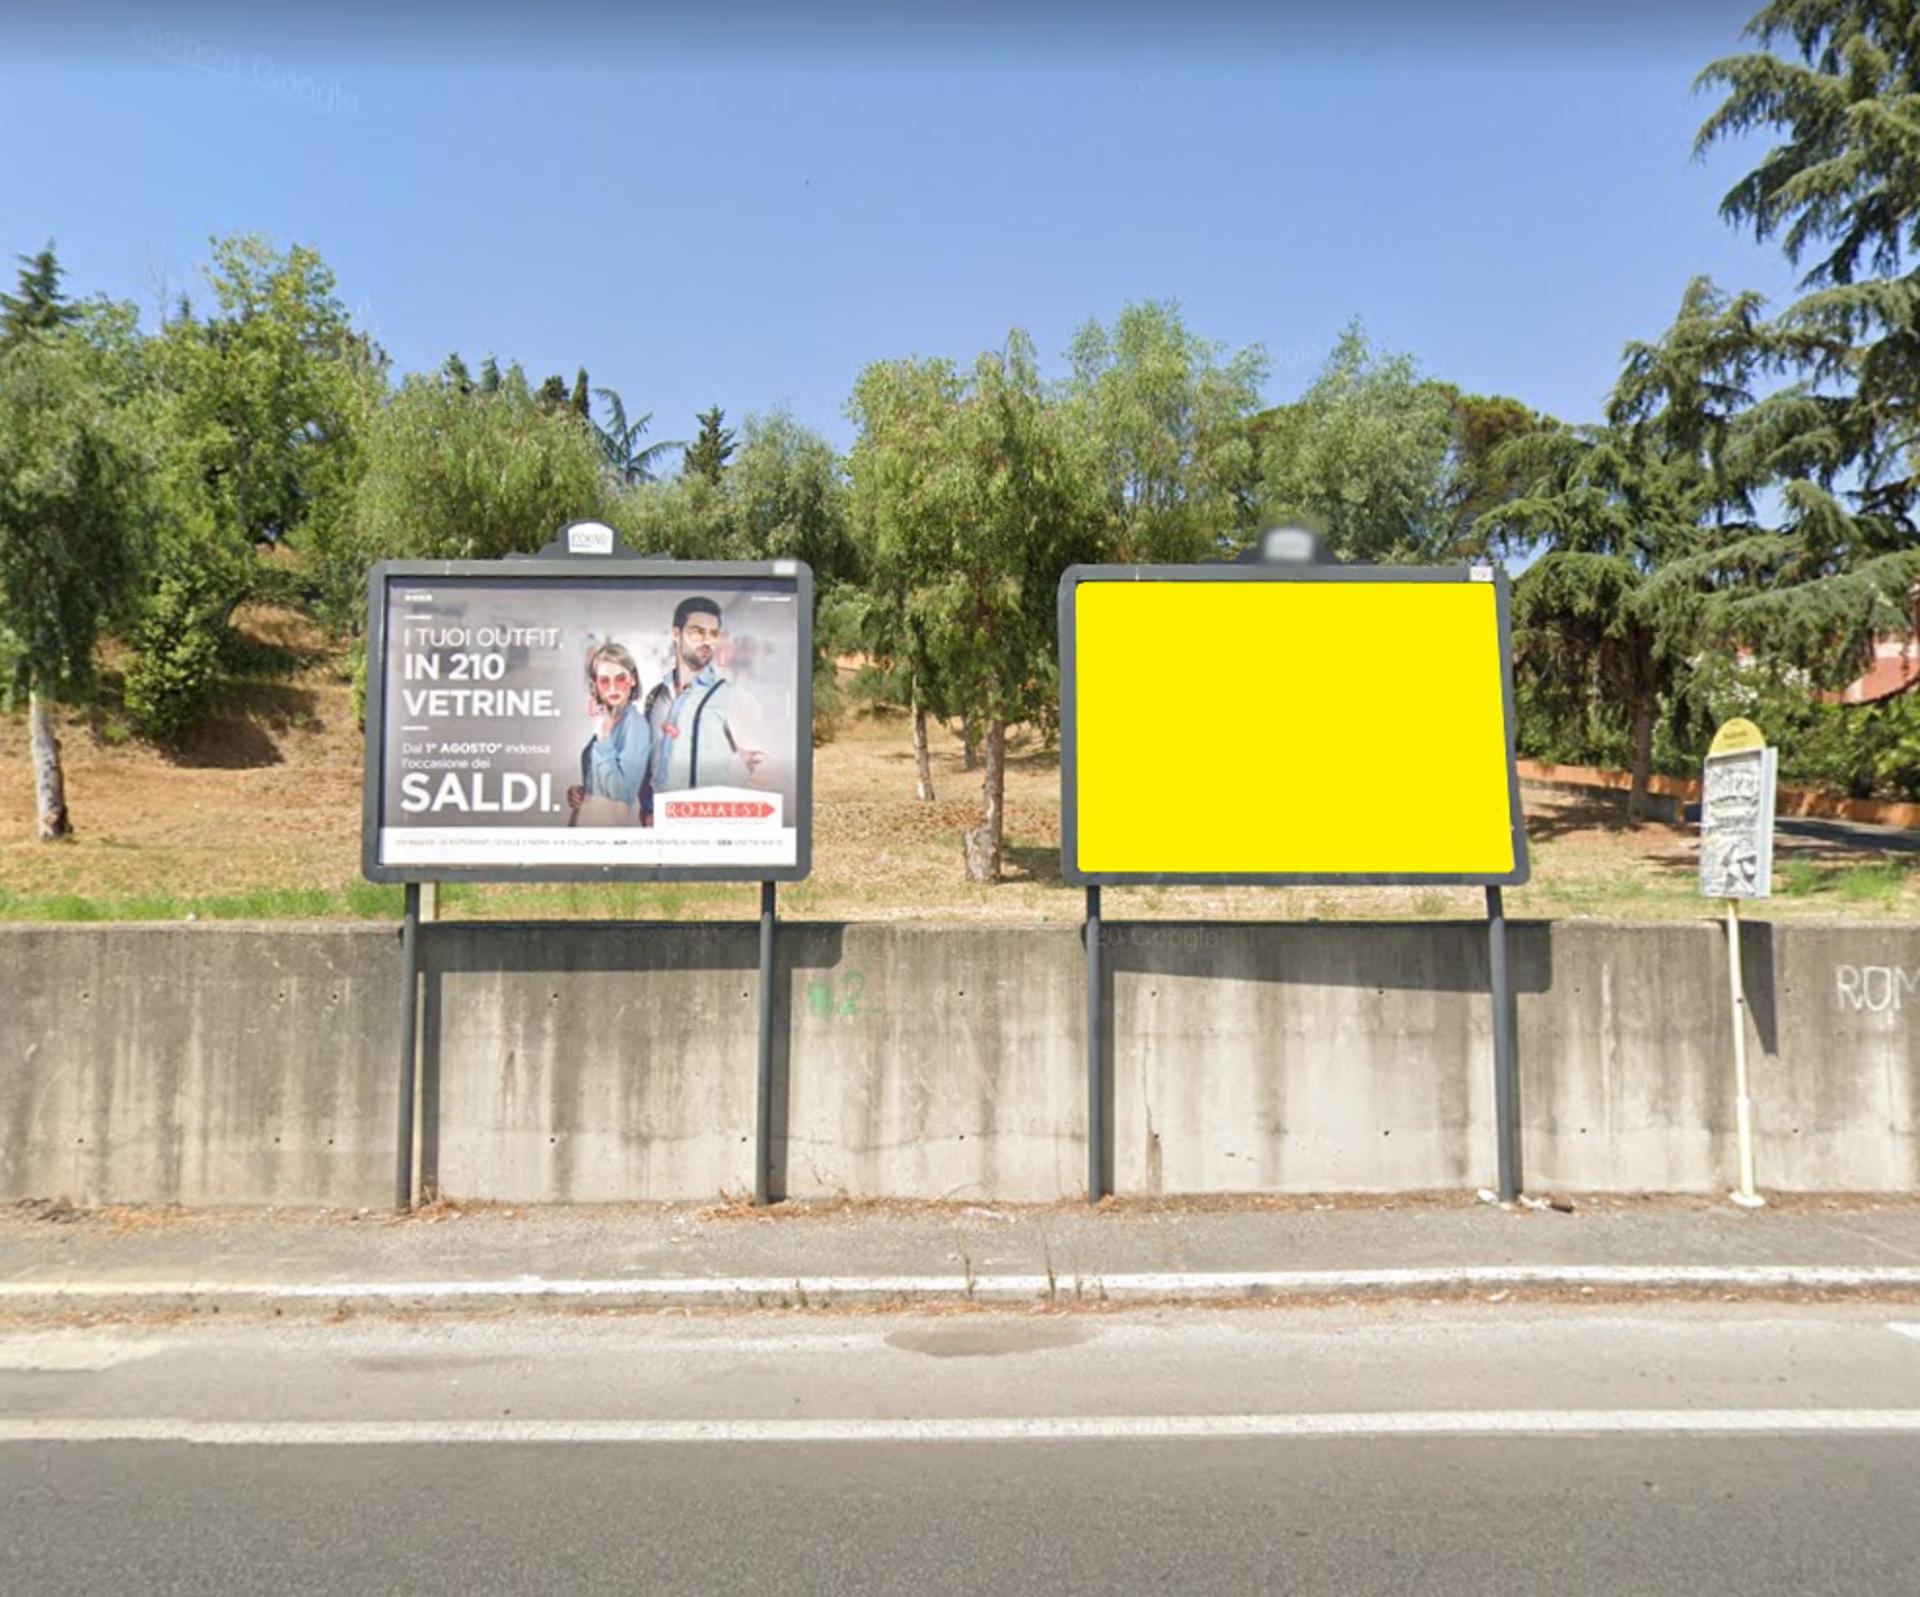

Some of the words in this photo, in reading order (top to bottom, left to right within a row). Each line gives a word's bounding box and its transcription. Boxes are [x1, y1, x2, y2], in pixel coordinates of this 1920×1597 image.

[403, 628, 411, 646] I
[416, 628, 470, 647] TUOI
[476, 627, 564, 650] OUTFIT,
[404, 652, 441, 680] IN
[448, 652, 505, 681] 210
[401, 688, 561, 717] VETRINE.
[403, 742, 423, 754] Dal
[506, 742, 551, 754] indossa
[401, 757, 469, 769] l'occasione
[471, 757, 491, 769] dei
[400, 771, 561, 813] SALDI.
